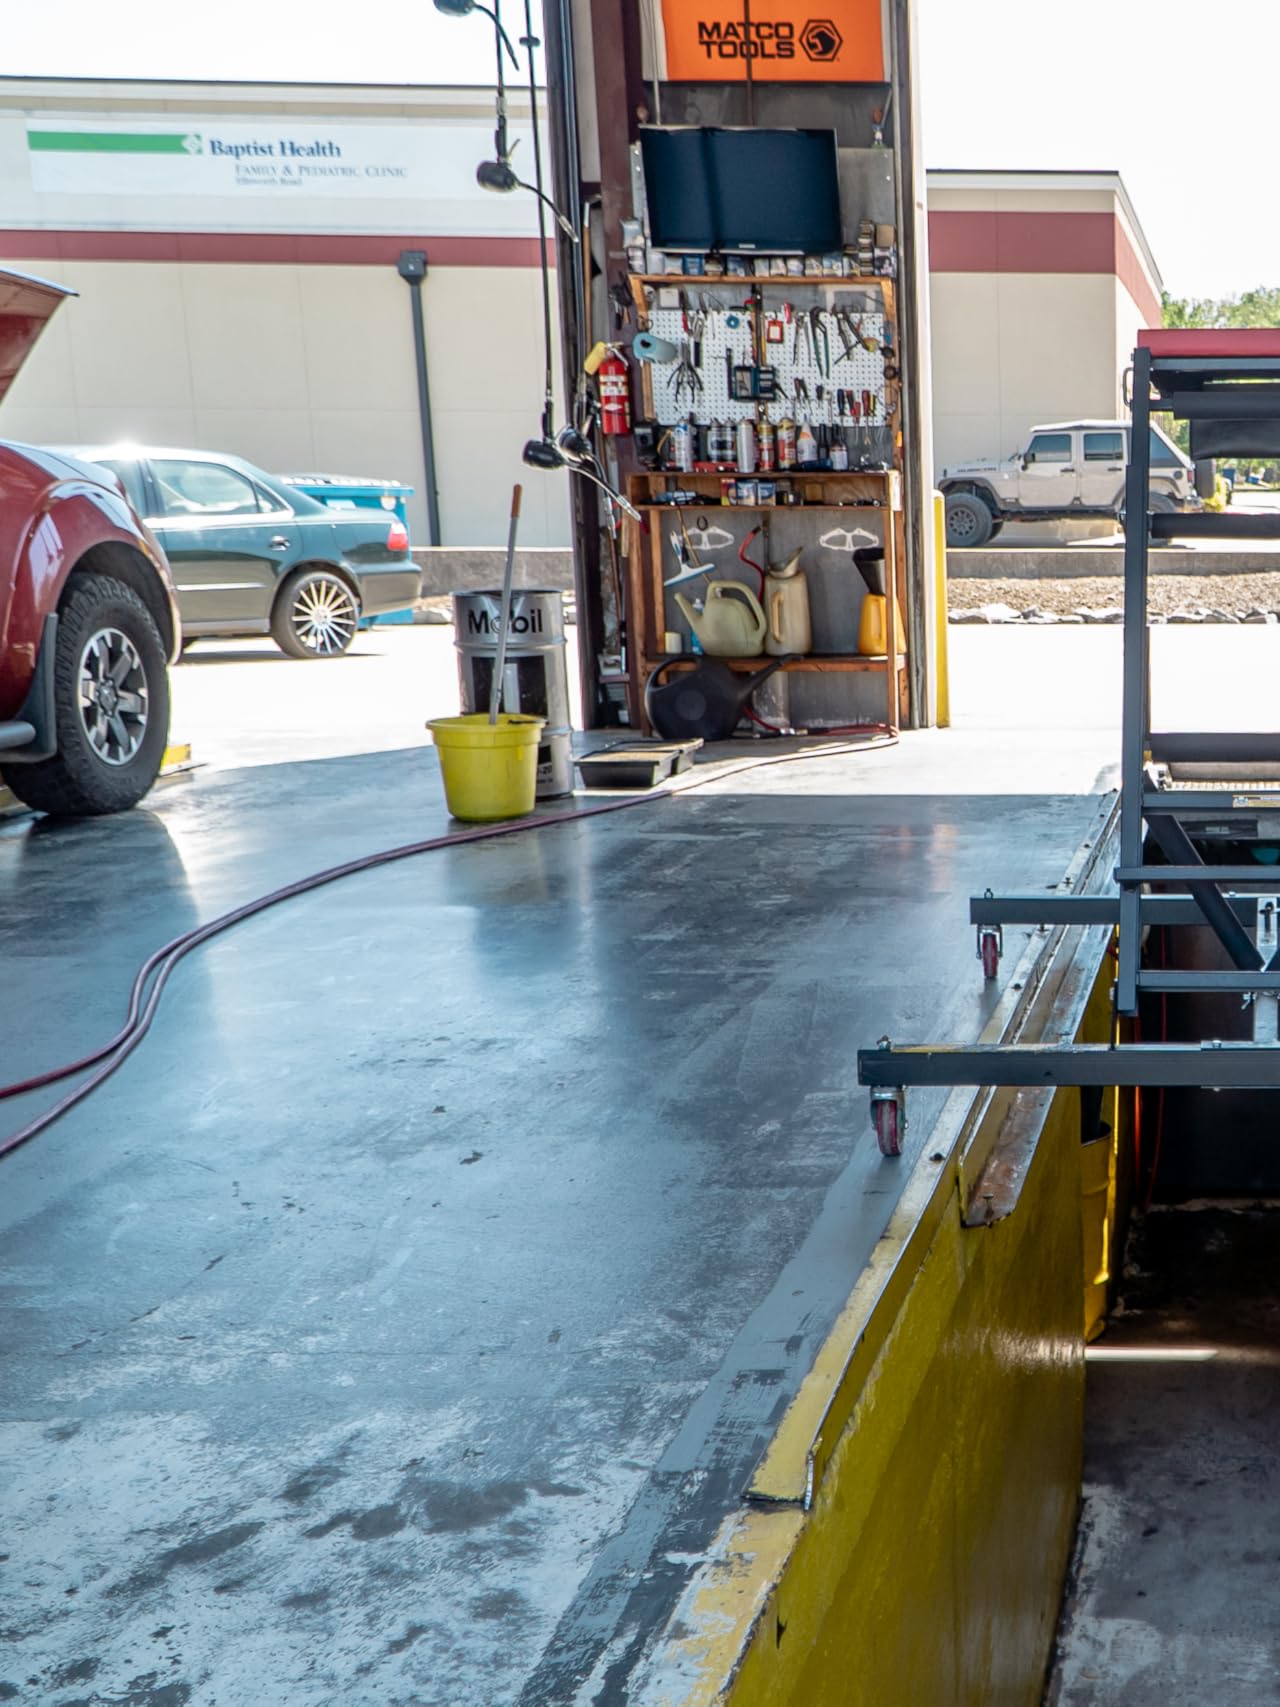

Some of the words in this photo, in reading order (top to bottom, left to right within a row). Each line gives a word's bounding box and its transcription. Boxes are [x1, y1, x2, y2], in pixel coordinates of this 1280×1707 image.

[698, 21, 794, 40] MATCO
[699, 40, 795, 59] TOOLS
[210, 140, 274, 160] Baptist
[280, 140, 342, 158] Health
[235, 164, 278, 176] FAMILY
[283, 164, 294, 176] &
[299, 165, 360, 177] PEDIATRIC
[365, 165, 408, 178] CLINIC
